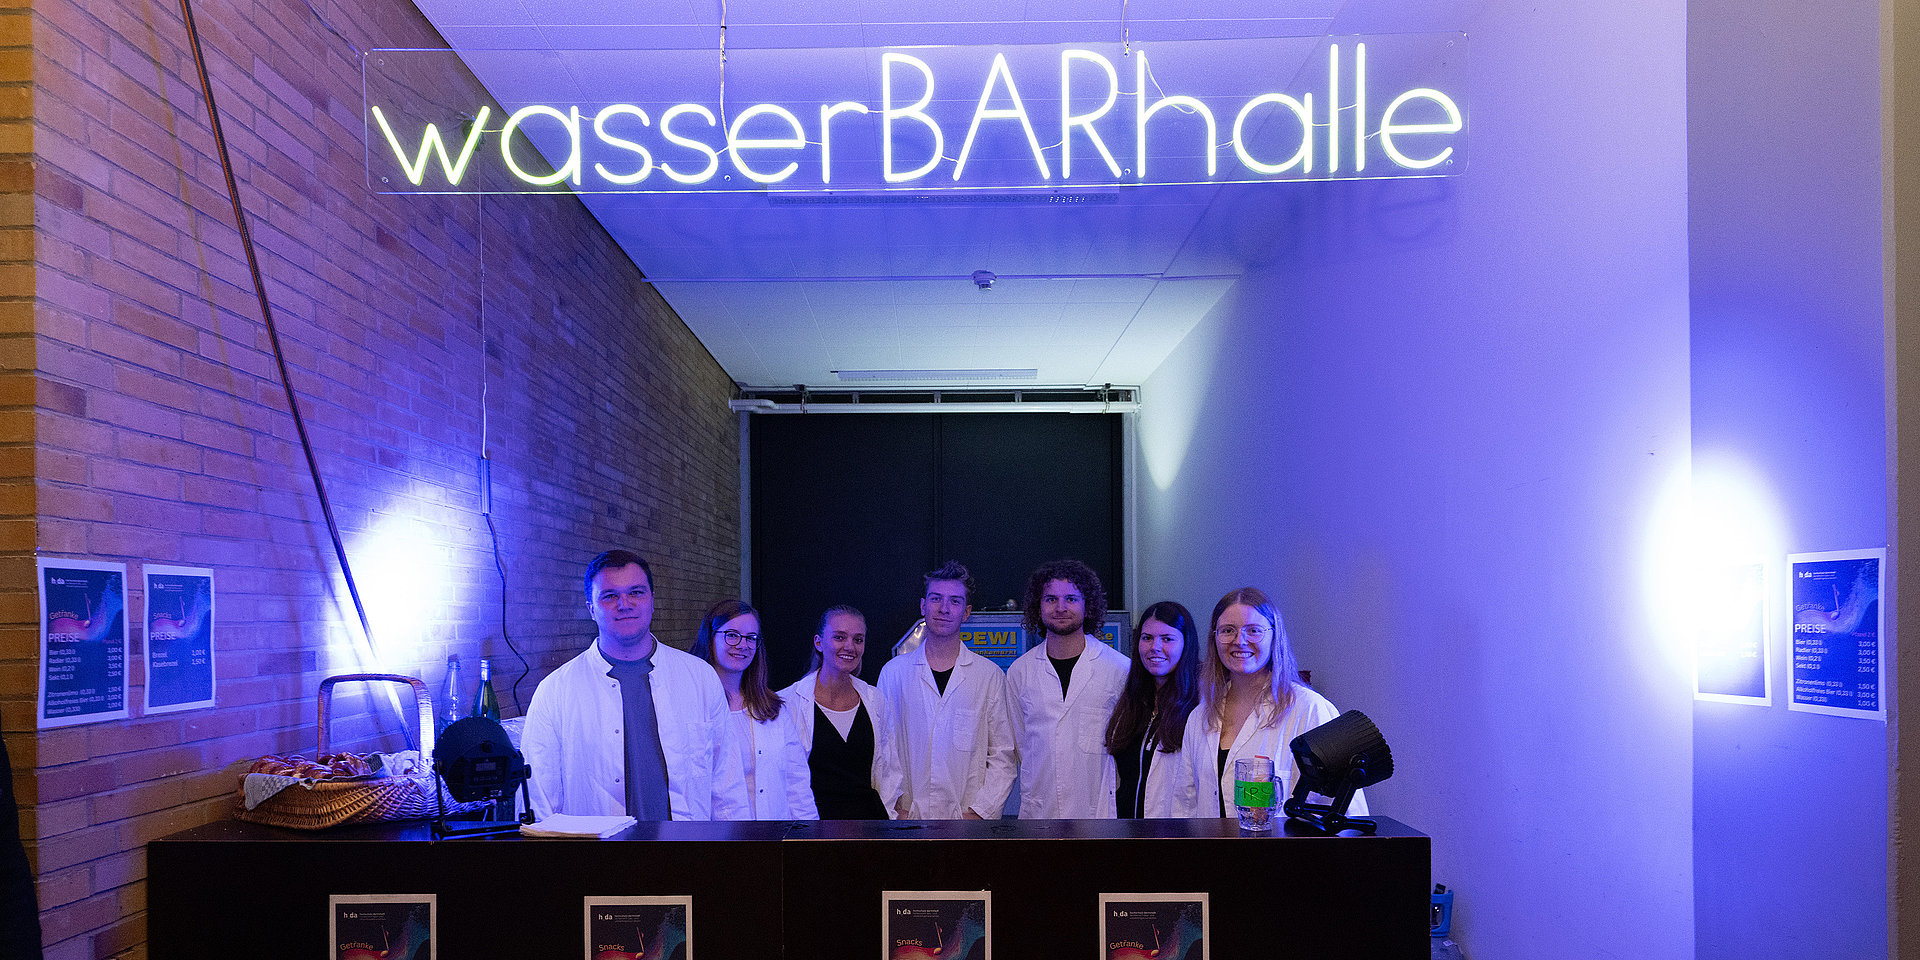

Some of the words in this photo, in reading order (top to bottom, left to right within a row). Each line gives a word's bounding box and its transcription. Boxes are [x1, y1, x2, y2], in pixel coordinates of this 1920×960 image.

[372, 42, 1464, 186] wasserBARhalle
[1795, 624, 1826, 634] PREISE
[48, 632, 80, 642] PREISE
[150, 632, 176, 640] PREISE
[340, 941, 374, 950] Getränke
[896, 938, 923, 947] Snacks
[1110, 940, 1144, 950] Getränke
